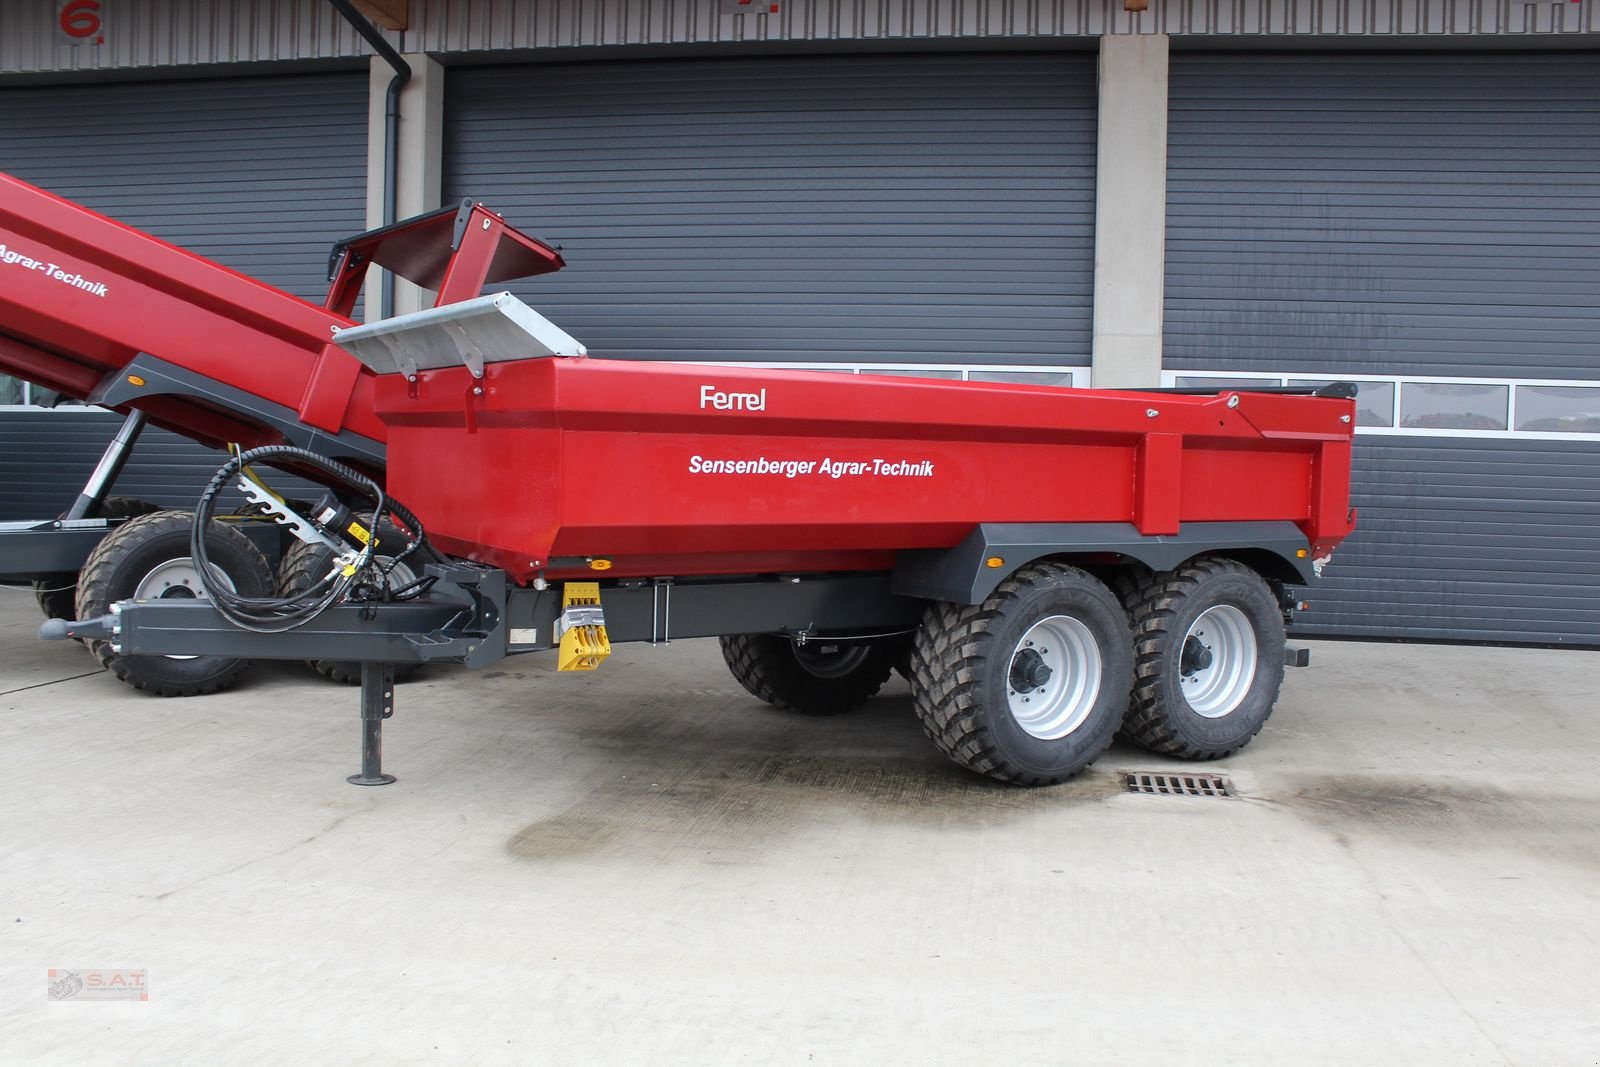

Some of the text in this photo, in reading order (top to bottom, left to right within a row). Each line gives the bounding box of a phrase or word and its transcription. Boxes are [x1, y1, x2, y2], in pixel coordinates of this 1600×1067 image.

[700, 385, 766, 411] Ferrel
[688, 455, 934, 478] Sensenberger Agrar-Technik
